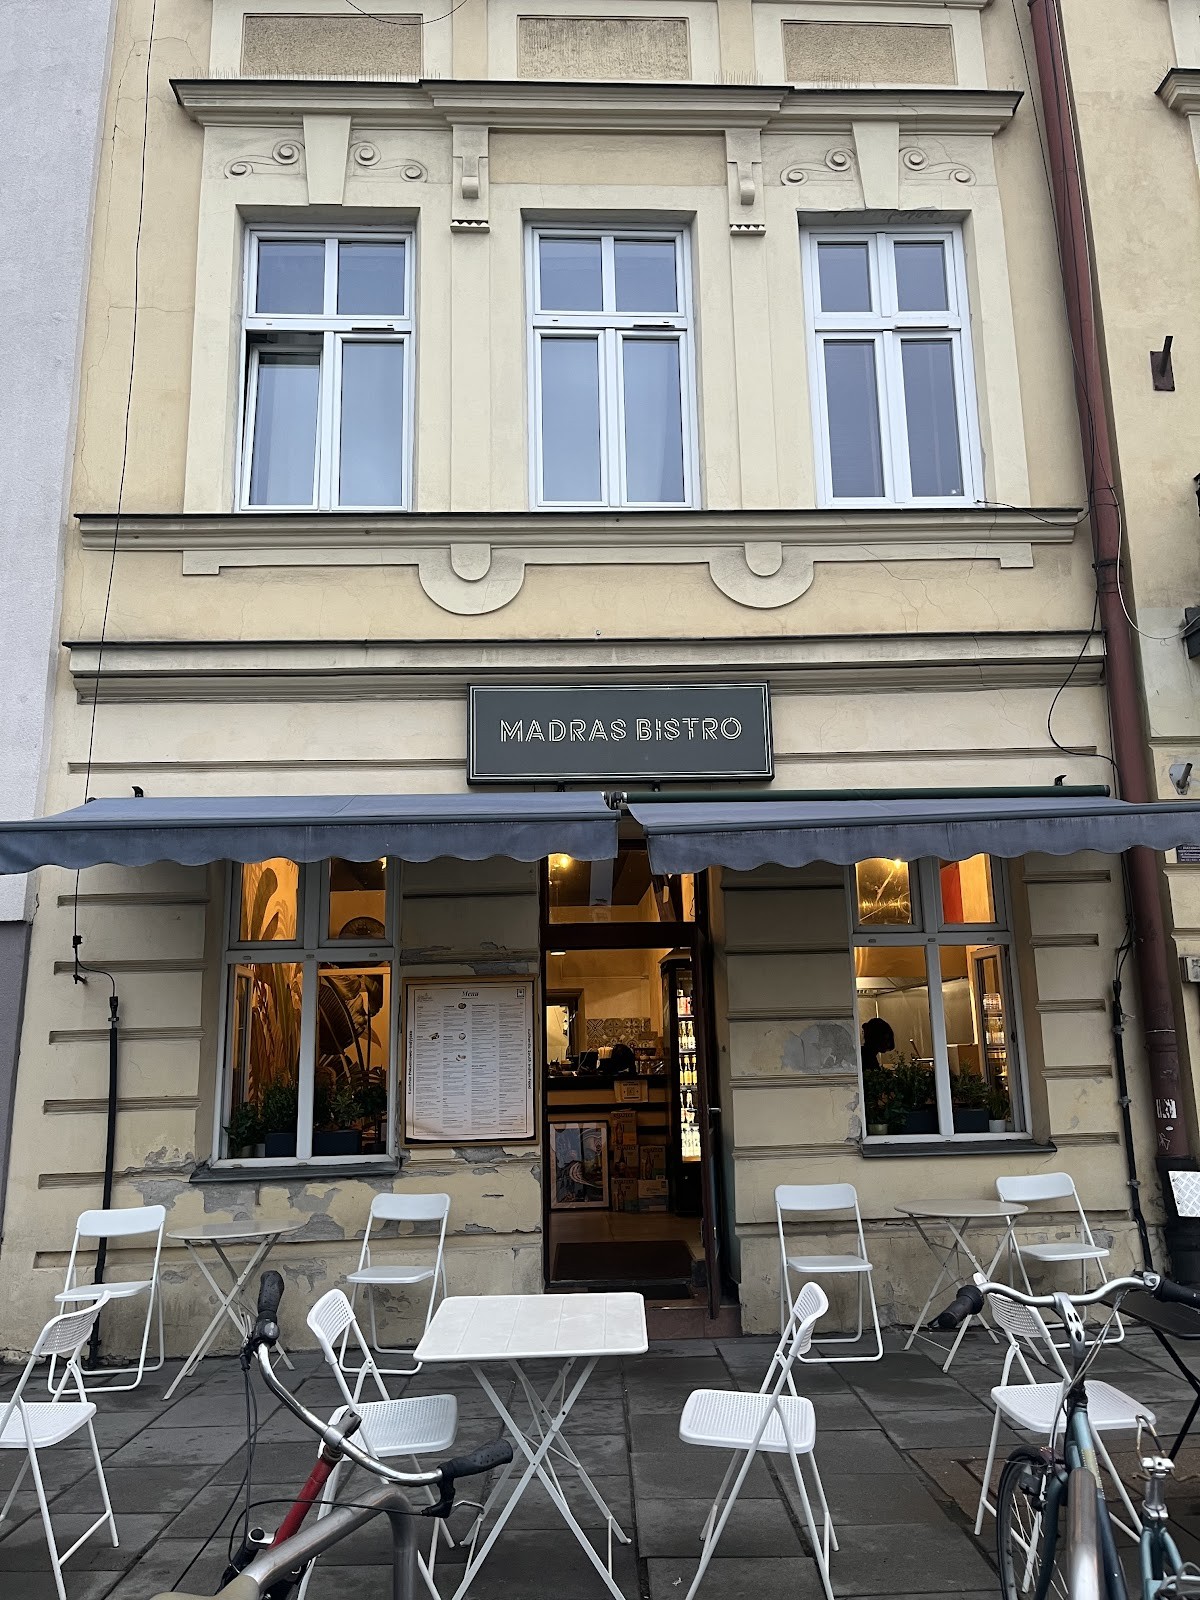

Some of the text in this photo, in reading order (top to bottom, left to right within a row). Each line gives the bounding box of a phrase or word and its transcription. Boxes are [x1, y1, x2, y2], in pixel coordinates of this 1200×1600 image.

[500, 717, 742, 742] MADRAS BISTRO
[461, 990, 479, 998] Menu
